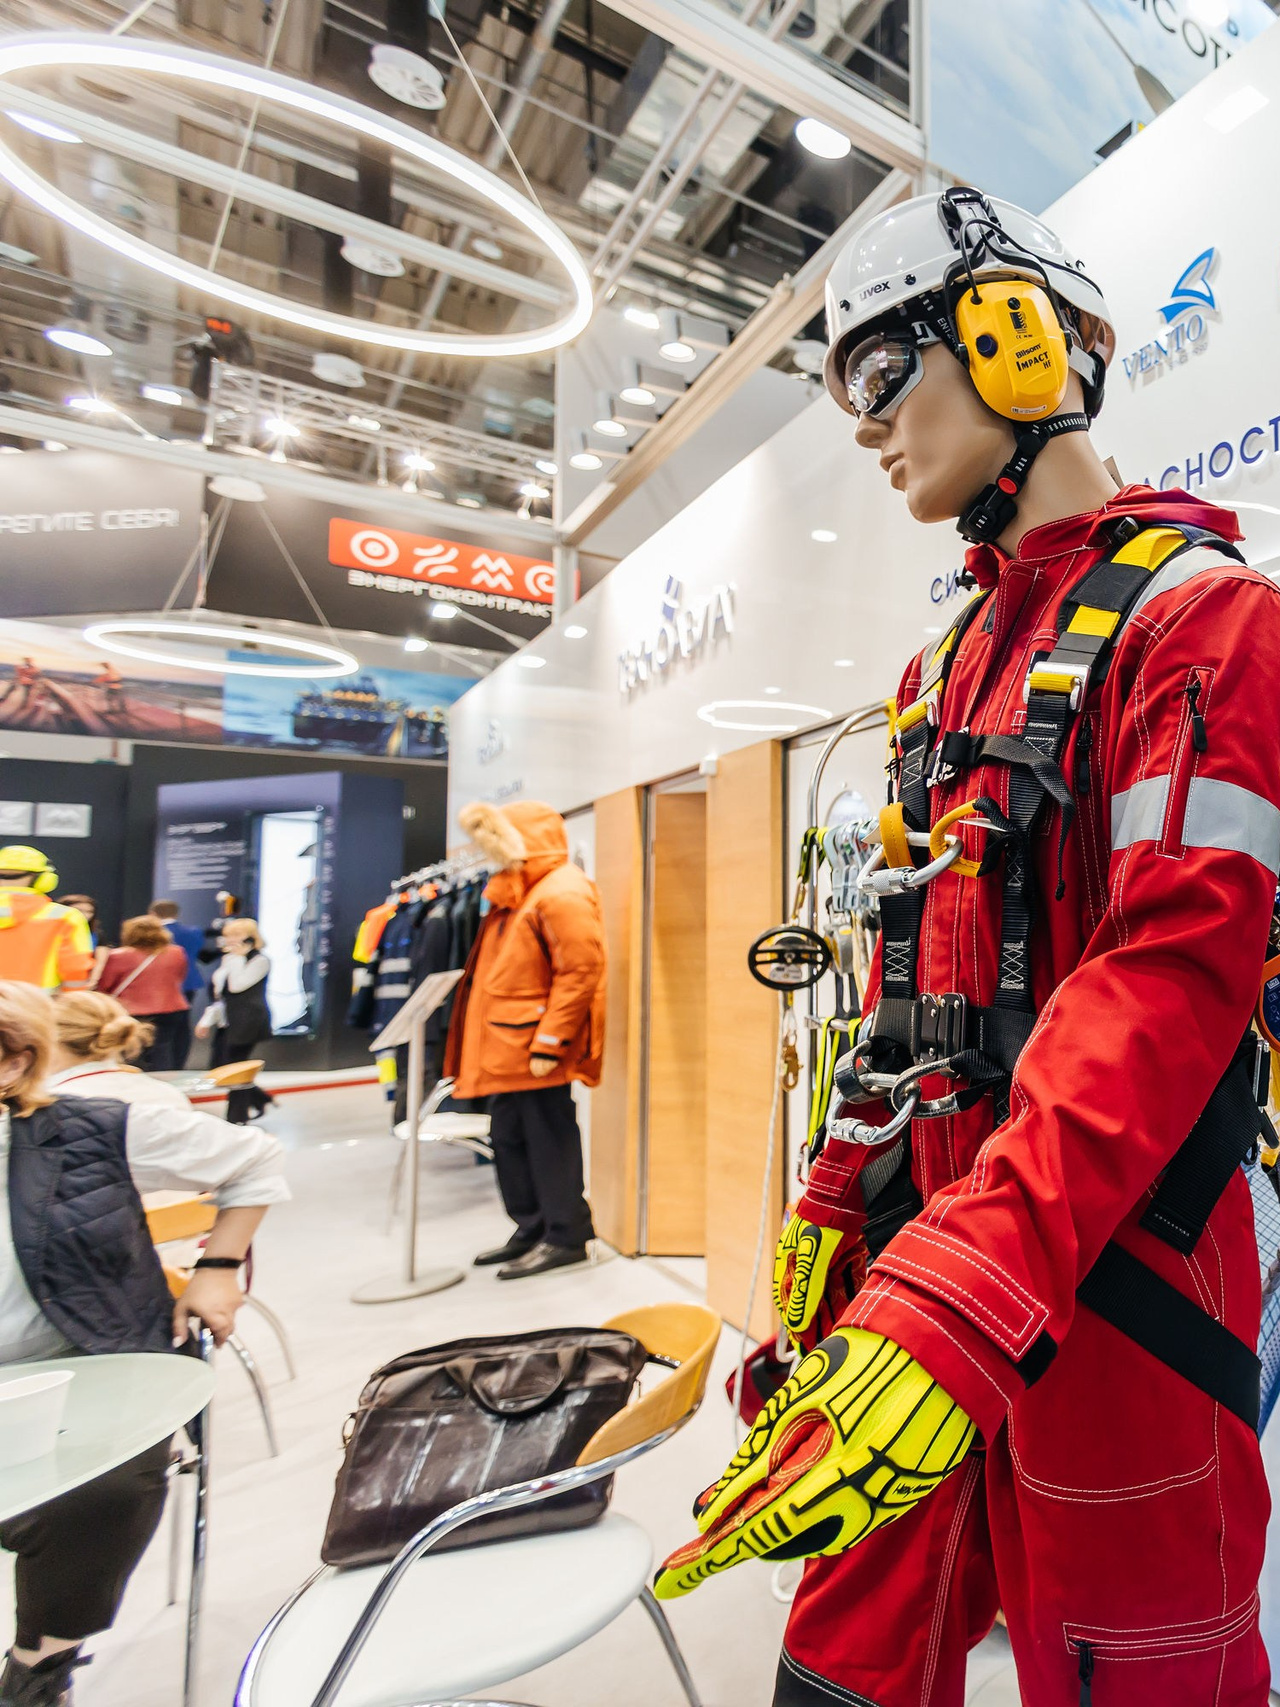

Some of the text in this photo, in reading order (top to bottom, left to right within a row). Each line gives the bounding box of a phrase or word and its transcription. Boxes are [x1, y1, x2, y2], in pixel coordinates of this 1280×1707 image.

[1133, 0, 1231, 69] СОТ
[859, 281, 891, 301] uvex
[1015, 343, 1041, 359] Bilsom
[1122, 314, 1203, 379] VENTO
[348, 569, 554, 618] ЭНЕРГОКОНТРАК
